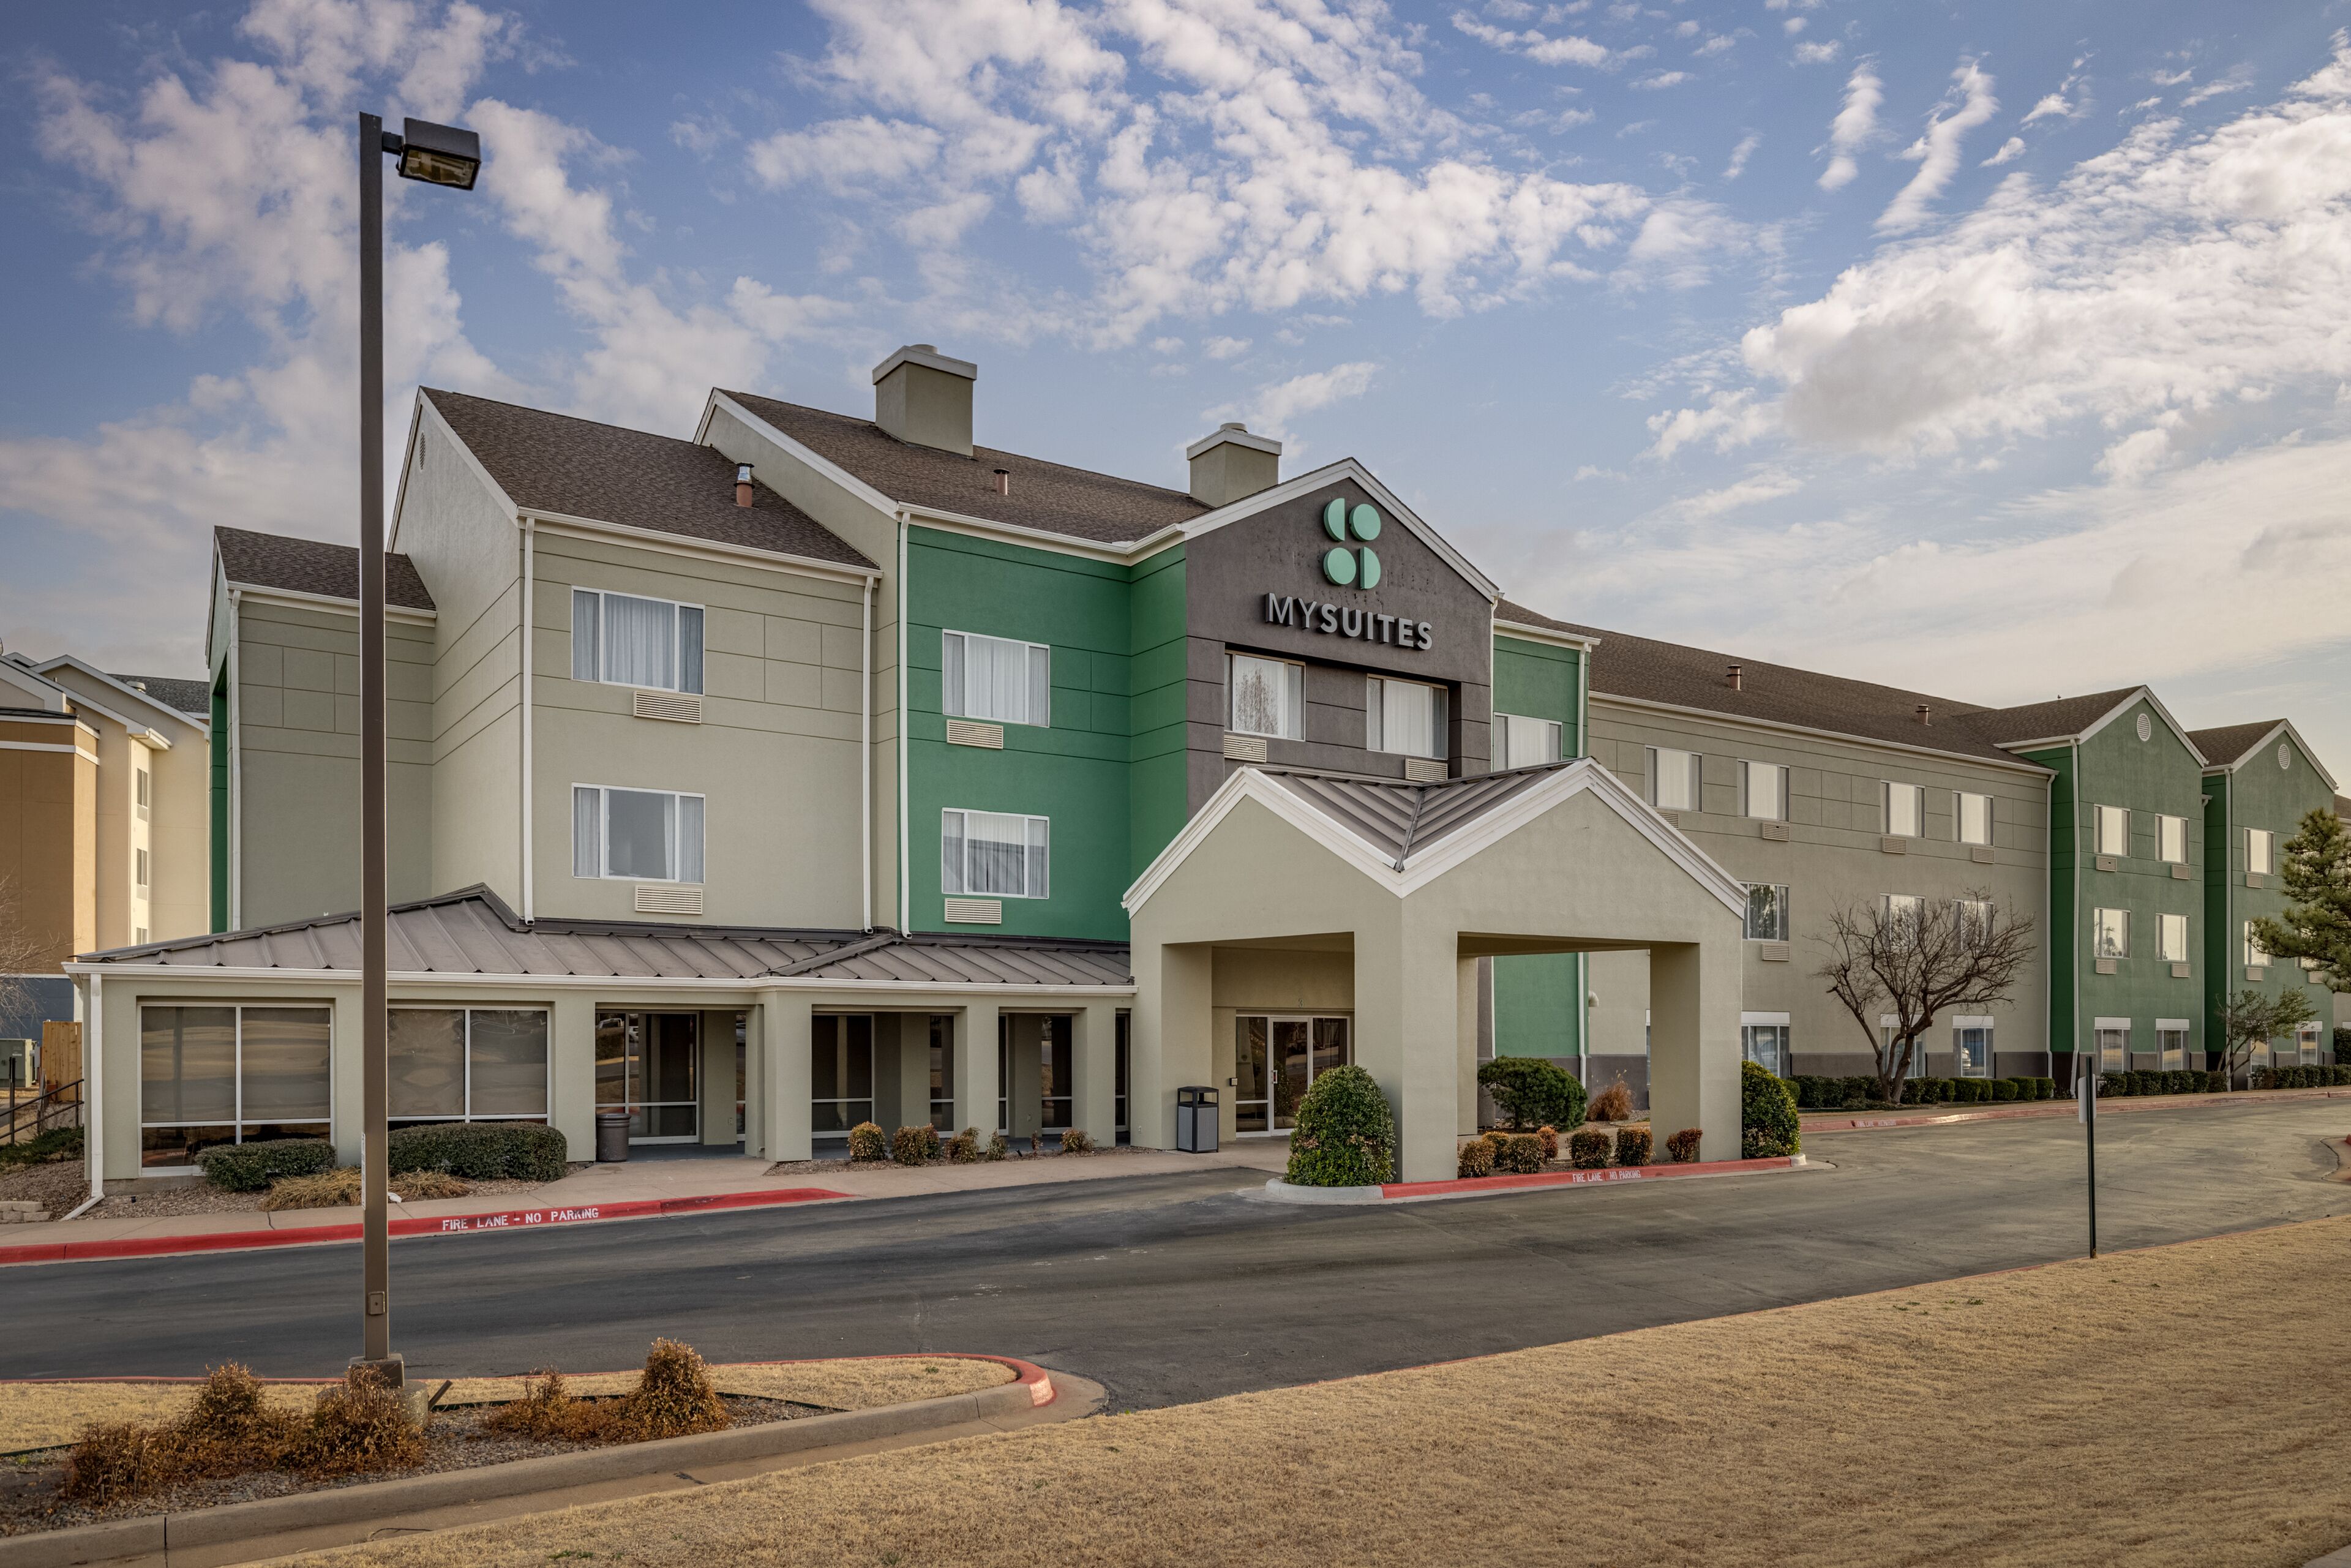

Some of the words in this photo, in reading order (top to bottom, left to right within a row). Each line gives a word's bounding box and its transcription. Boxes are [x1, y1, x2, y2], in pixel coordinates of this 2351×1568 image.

[1265, 593, 1432, 650] MYSUITES
[1573, 1174, 1586, 1182] FIRE
[1587, 1172, 1603, 1182] LANE
[1609, 1171, 1618, 1180] NO
[1619, 1170, 1641, 1179] PARKING
[443, 1219, 468, 1231] FIRE
[477, 1215, 509, 1228] LANE
[525, 1213, 542, 1223] NO
[551, 1208, 599, 1221] PARKING
